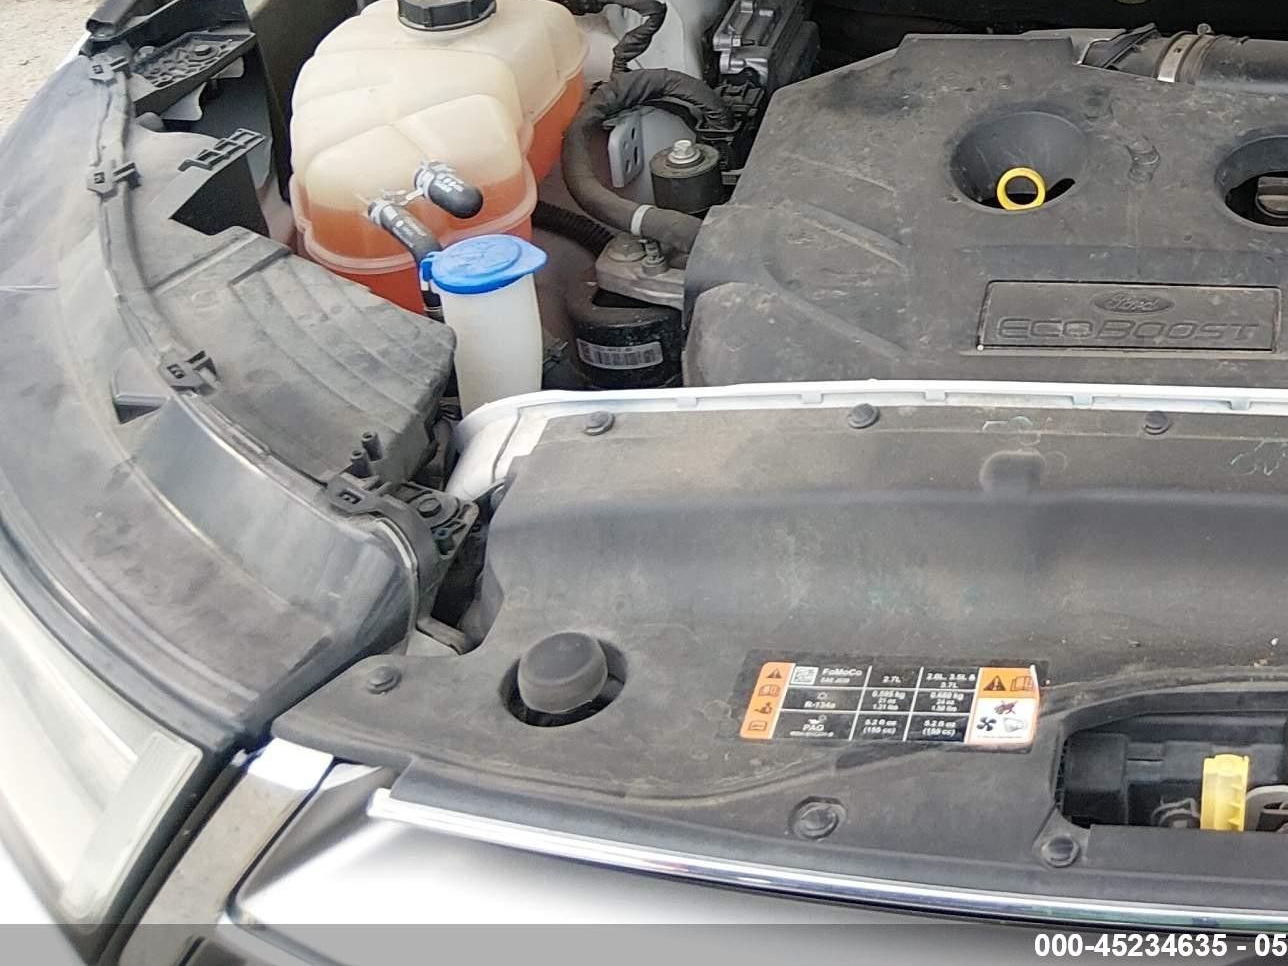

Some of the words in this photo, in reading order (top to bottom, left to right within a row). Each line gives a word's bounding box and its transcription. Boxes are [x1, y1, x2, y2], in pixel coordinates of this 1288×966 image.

[1108, 291, 1163, 311] Ford
[822, 668, 863, 676] FoMoCo
[882, 675, 902, 683] 2.7L
